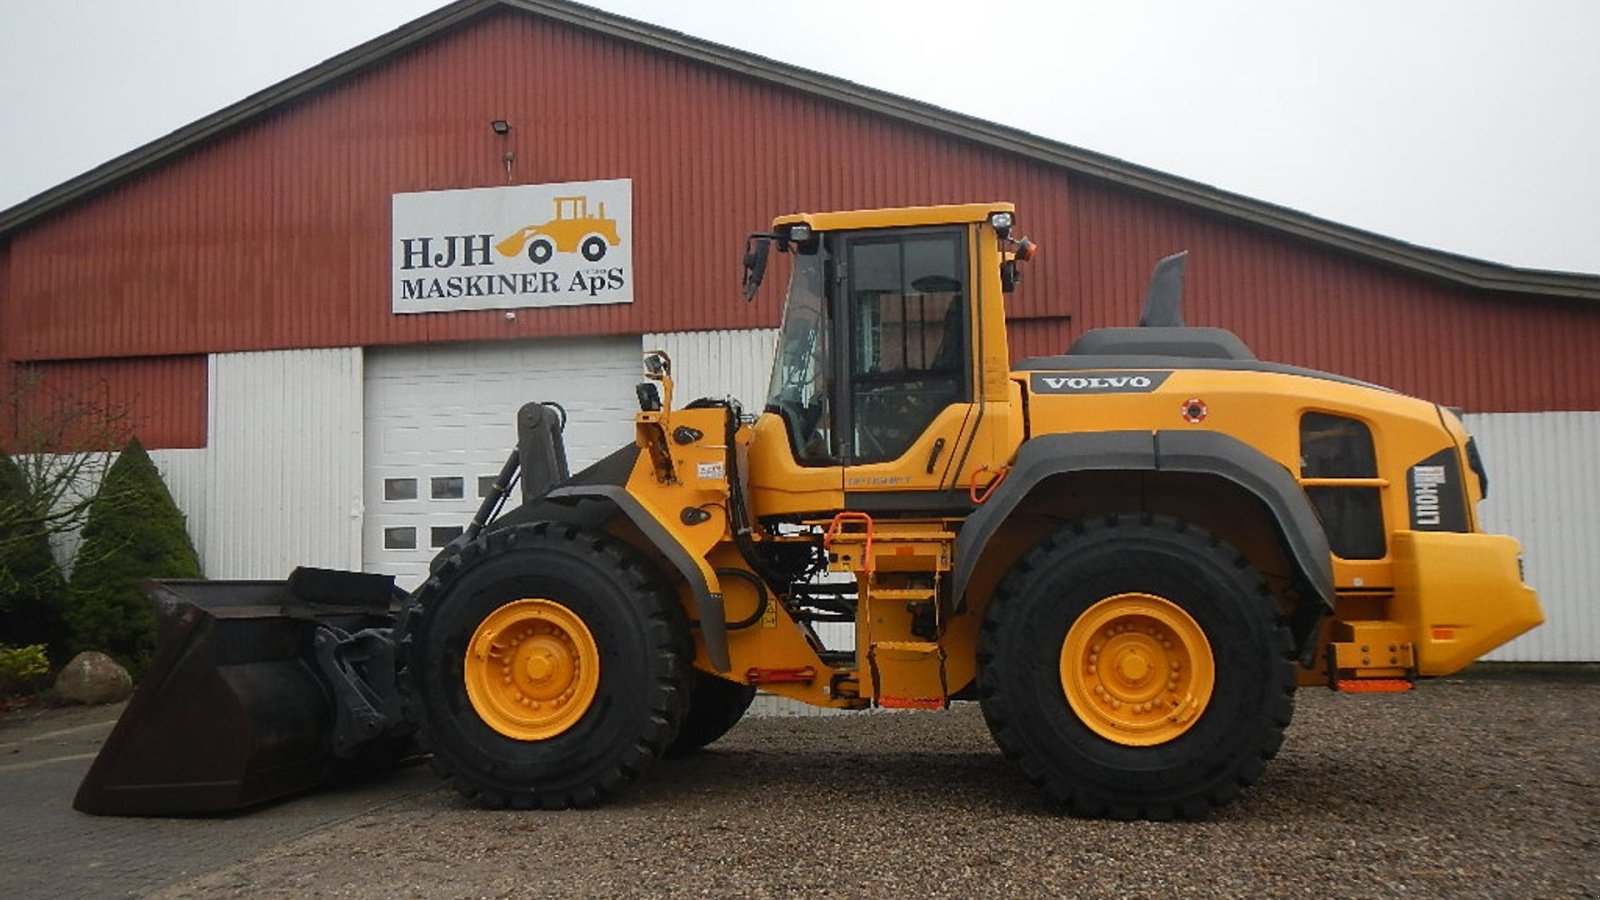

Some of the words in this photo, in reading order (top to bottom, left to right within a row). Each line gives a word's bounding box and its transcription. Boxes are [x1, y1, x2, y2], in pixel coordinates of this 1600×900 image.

[400, 234, 494, 269] HJH
[401, 271, 560, 299] MASKINER
[567, 267, 625, 296] ApS
[1042, 376, 1151, 389] VOLVO
